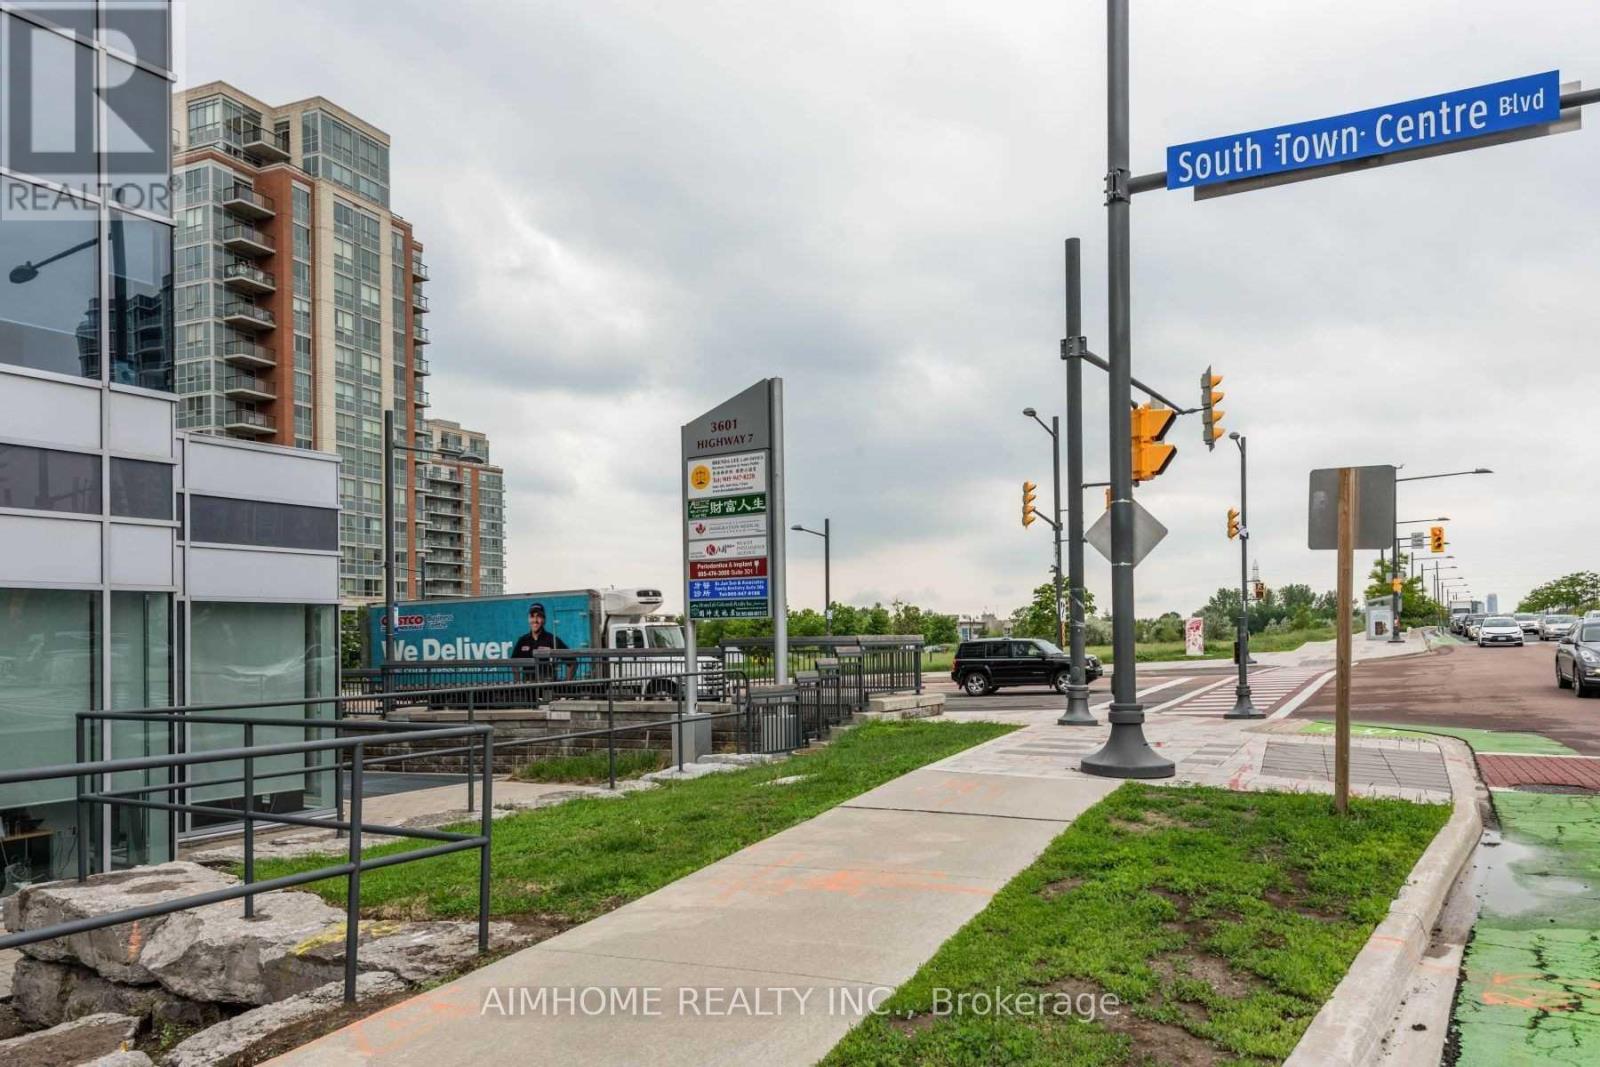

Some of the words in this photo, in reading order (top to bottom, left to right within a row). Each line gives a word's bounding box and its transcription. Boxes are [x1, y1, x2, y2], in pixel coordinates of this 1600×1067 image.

[1179, 136, 1262, 183] South
[1278, 128, 1359, 166] Town
[1375, 99, 1487, 147] Centre
[1499, 88, 1545, 117] Blvd
[711, 419, 737, 432] 3601
[697, 434, 746, 448] HIGHWAY
[748, 434, 754, 443] 7
[710, 498, 765, 514] 財富人生
[381, 615, 424, 626] CSTCO
[381, 640, 418, 661] We
[422, 637, 512, 660] Deliver
